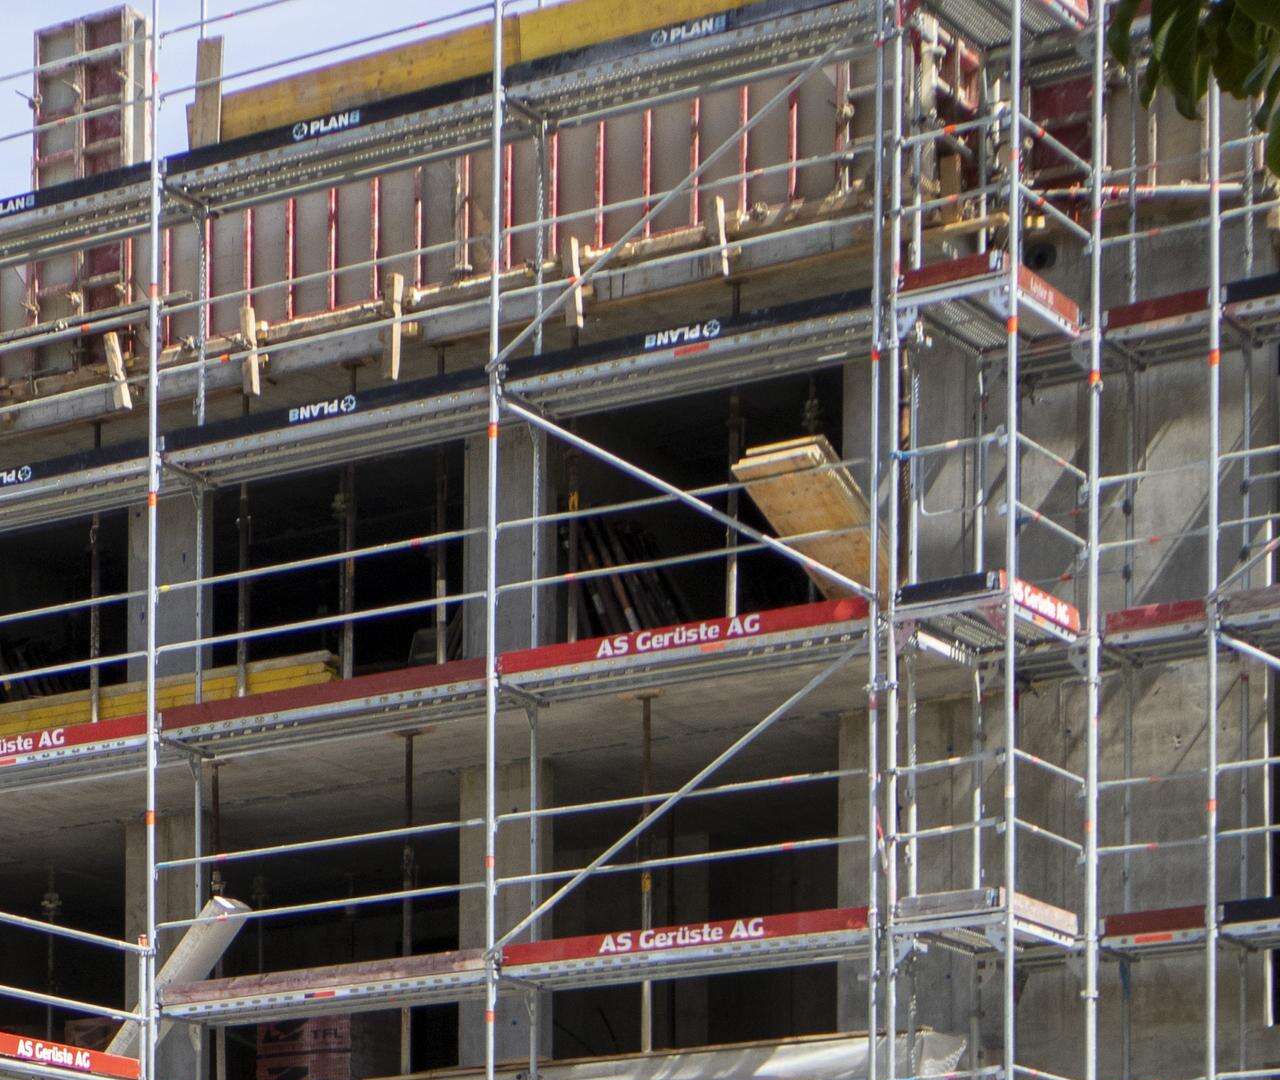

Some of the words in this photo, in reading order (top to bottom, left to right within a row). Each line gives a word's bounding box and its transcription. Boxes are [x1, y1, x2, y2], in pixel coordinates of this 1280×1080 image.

[597, 639, 628, 659] AS
[636, 624, 720, 651] Gerüste
[727, 614, 761, 637] AG
[38, 728, 65, 748] AG
[599, 933, 632, 954] AS
[639, 923, 724, 948] Gerüste
[730, 918, 765, 939] AG
[17, 1039, 33, 1057] AS
[35, 1043, 74, 1065] Gerüste
[75, 1051, 91, 1069] AG
